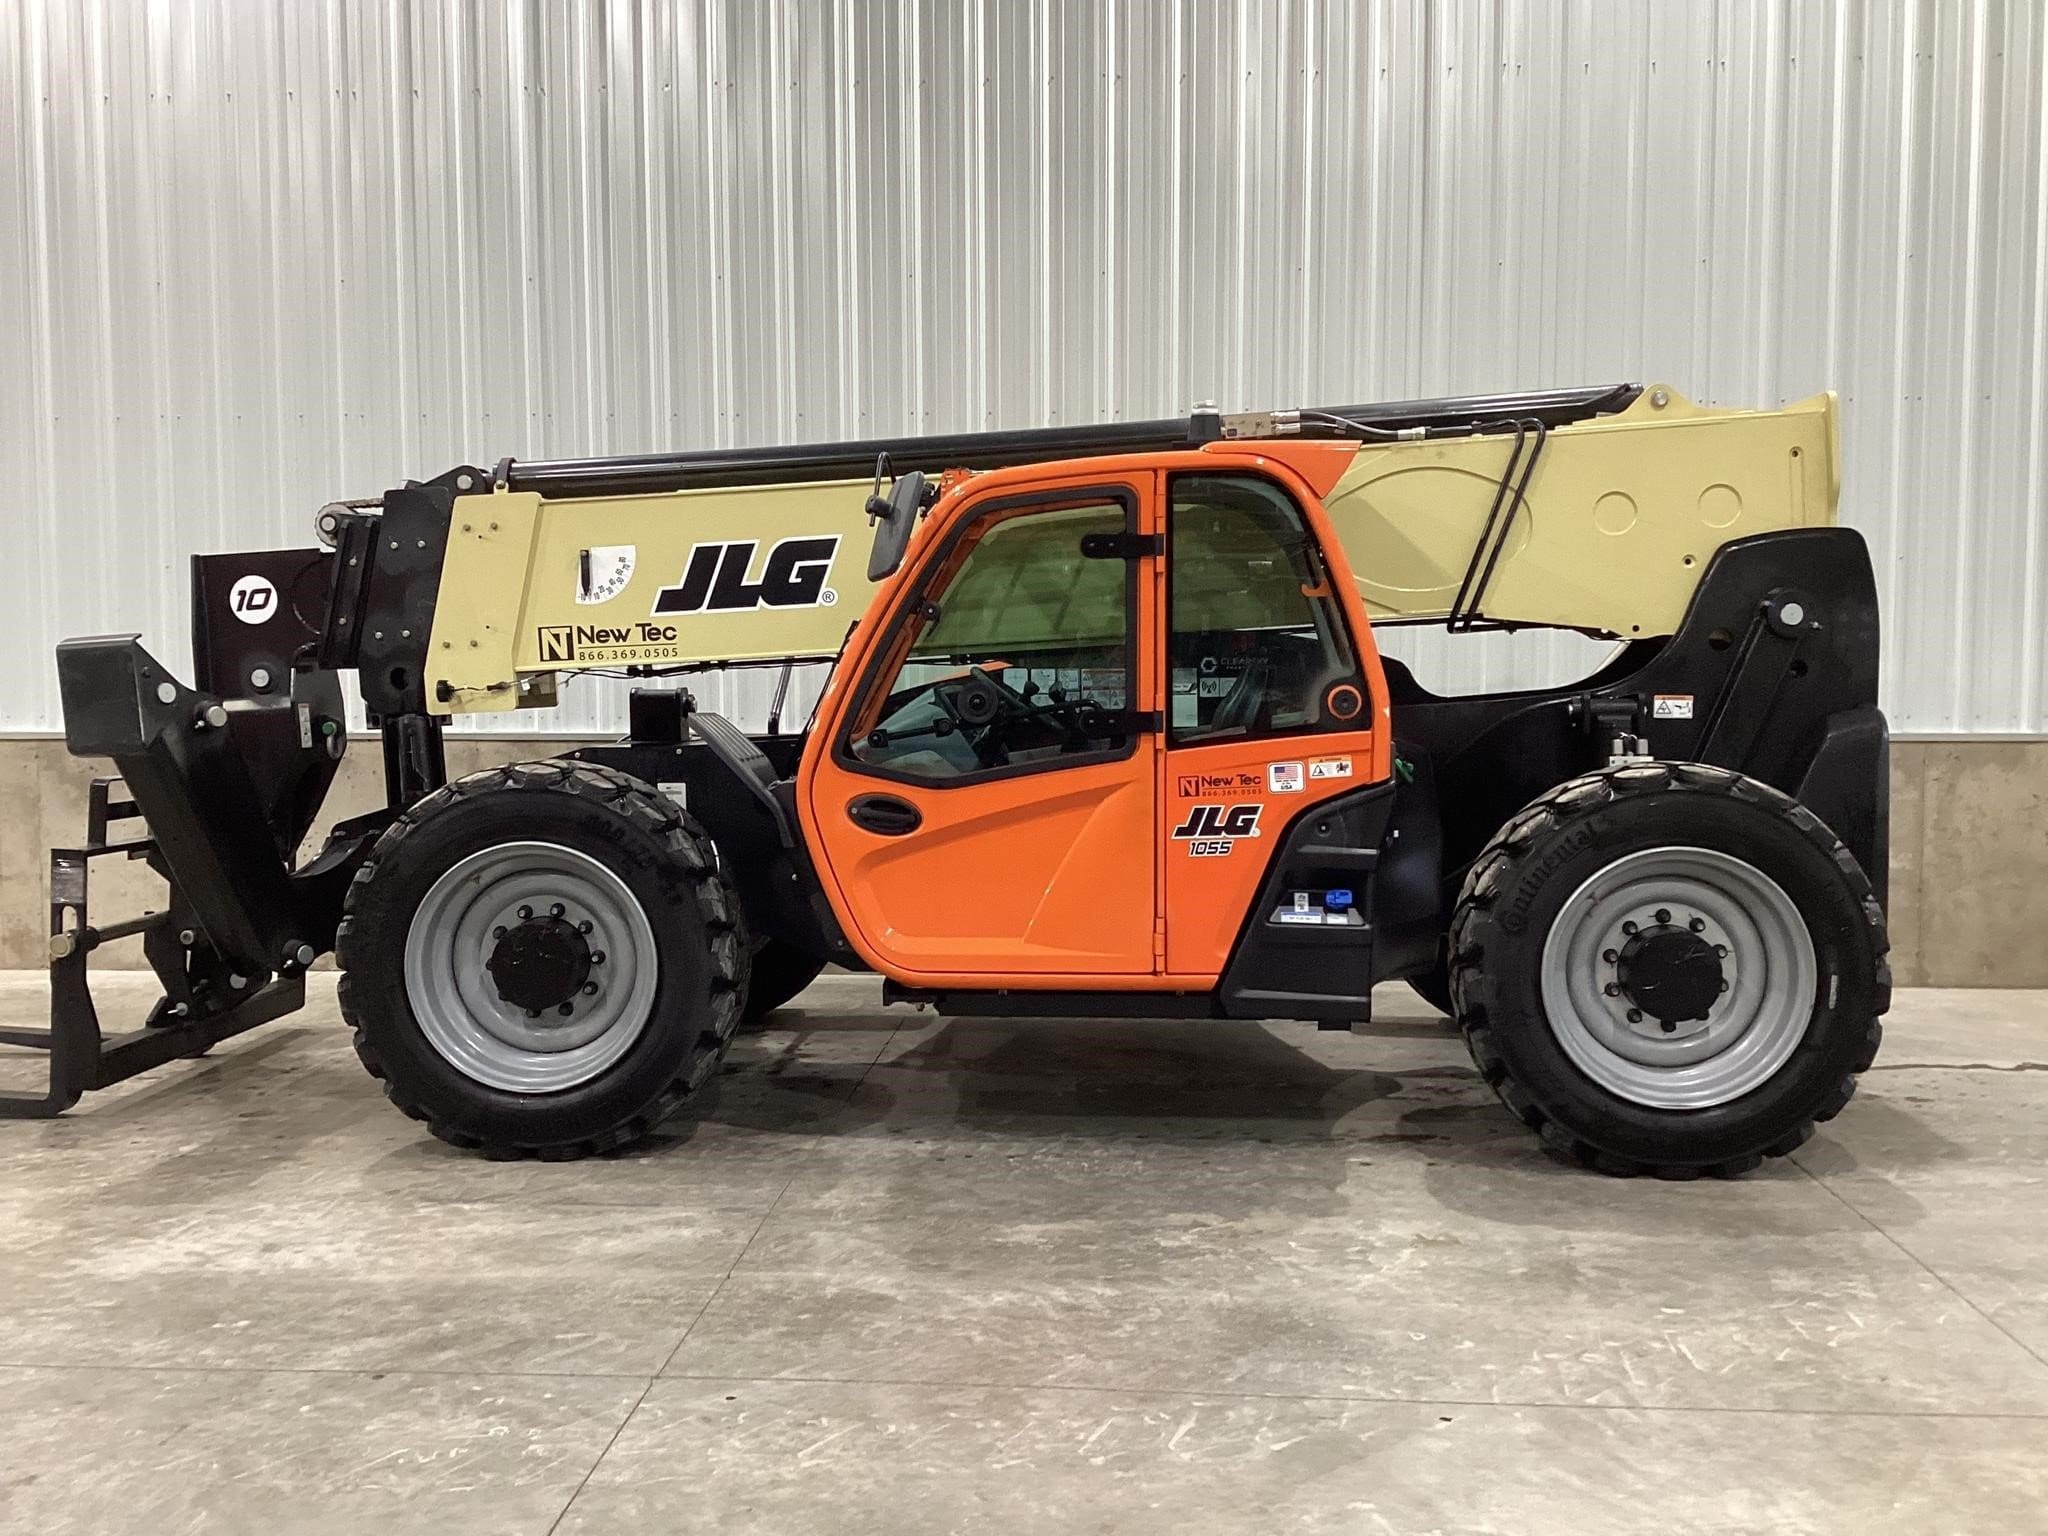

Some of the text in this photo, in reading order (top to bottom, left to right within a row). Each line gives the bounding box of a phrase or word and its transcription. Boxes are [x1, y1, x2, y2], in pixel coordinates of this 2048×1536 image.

[236, 587, 272, 612] 10
[577, 625, 631, 645] New
[635, 623, 677, 642] Tec
[579, 647, 679, 661] 866.369.0505
[1201, 776, 1234, 788] New
[1236, 773, 1262, 786] Tec
[1174, 806, 1260, 837] JLG
[1190, 841, 1233, 856] 1055
